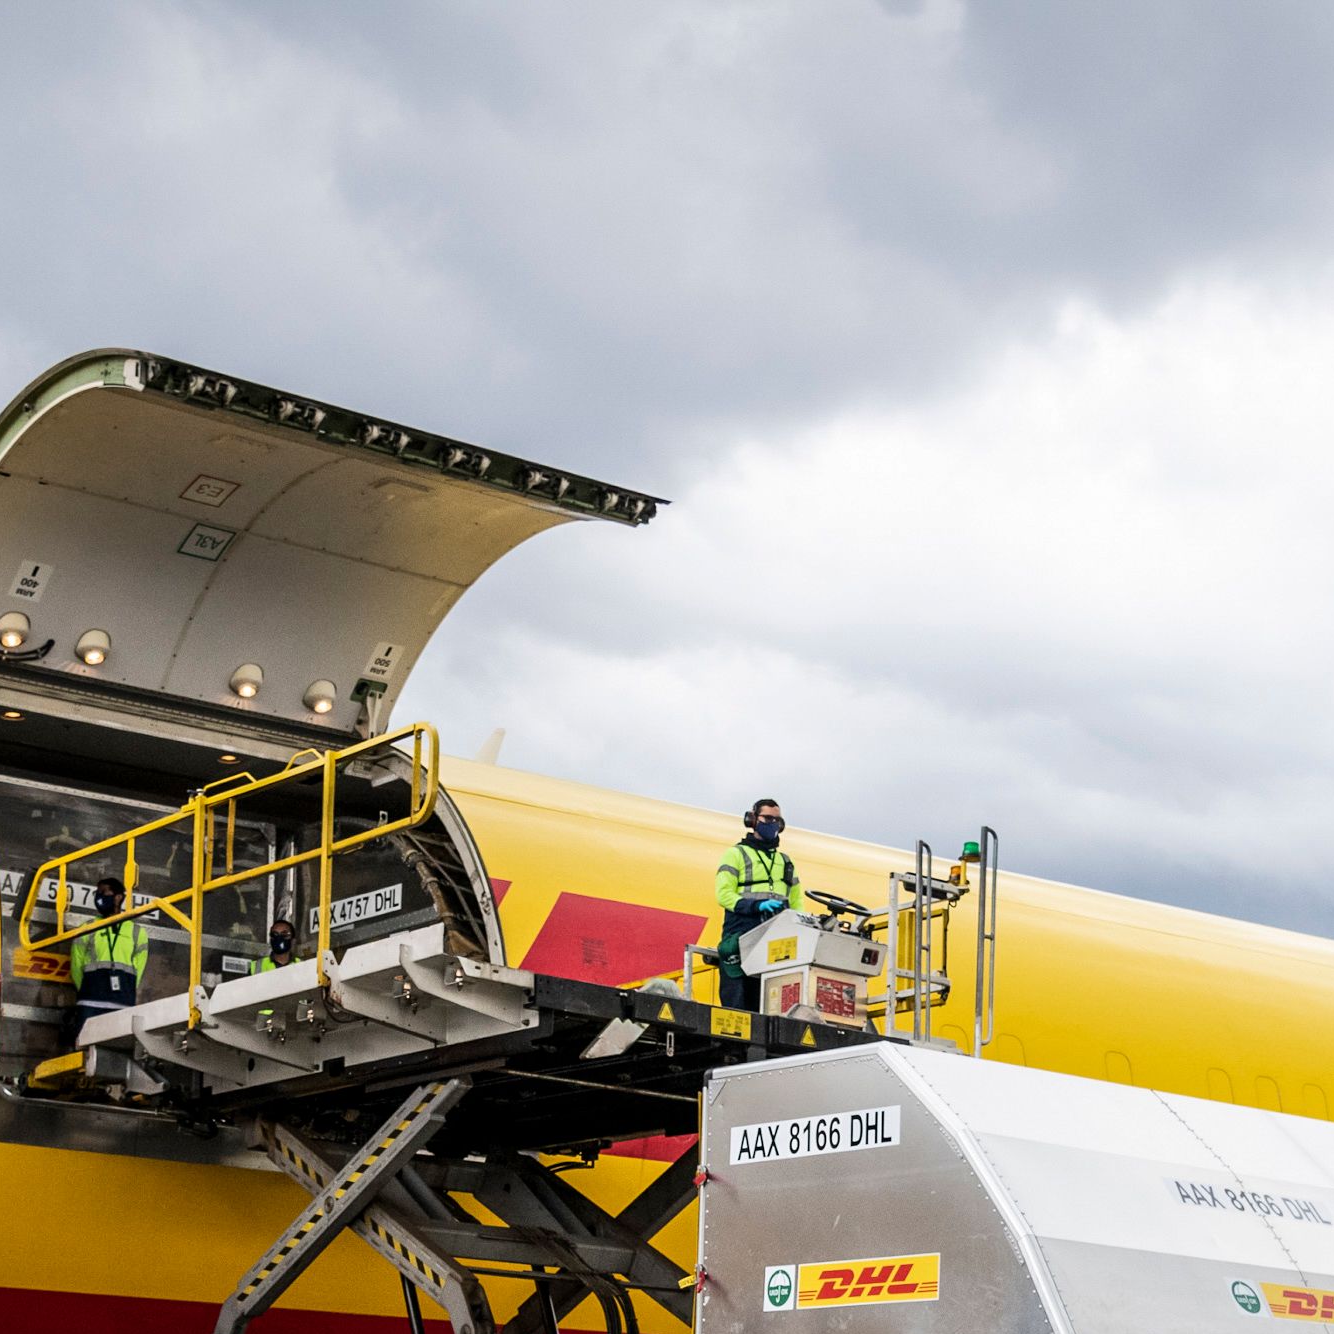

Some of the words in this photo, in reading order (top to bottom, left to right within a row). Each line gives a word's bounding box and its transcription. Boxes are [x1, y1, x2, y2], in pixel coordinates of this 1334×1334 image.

[312, 904, 337, 930] AX
[340, 897, 370, 922] 4757
[375, 889, 399, 912] DHL
[737, 1124, 780, 1161] AAX
[789, 1117, 841, 1154] 8166
[850, 1110, 892, 1147] DHL
[1175, 1180, 1226, 1209] AAX
[1224, 1188, 1284, 1217] 8166
[1282, 1197, 1332, 1225] DHL
[815, 1263, 919, 1301] DHL
